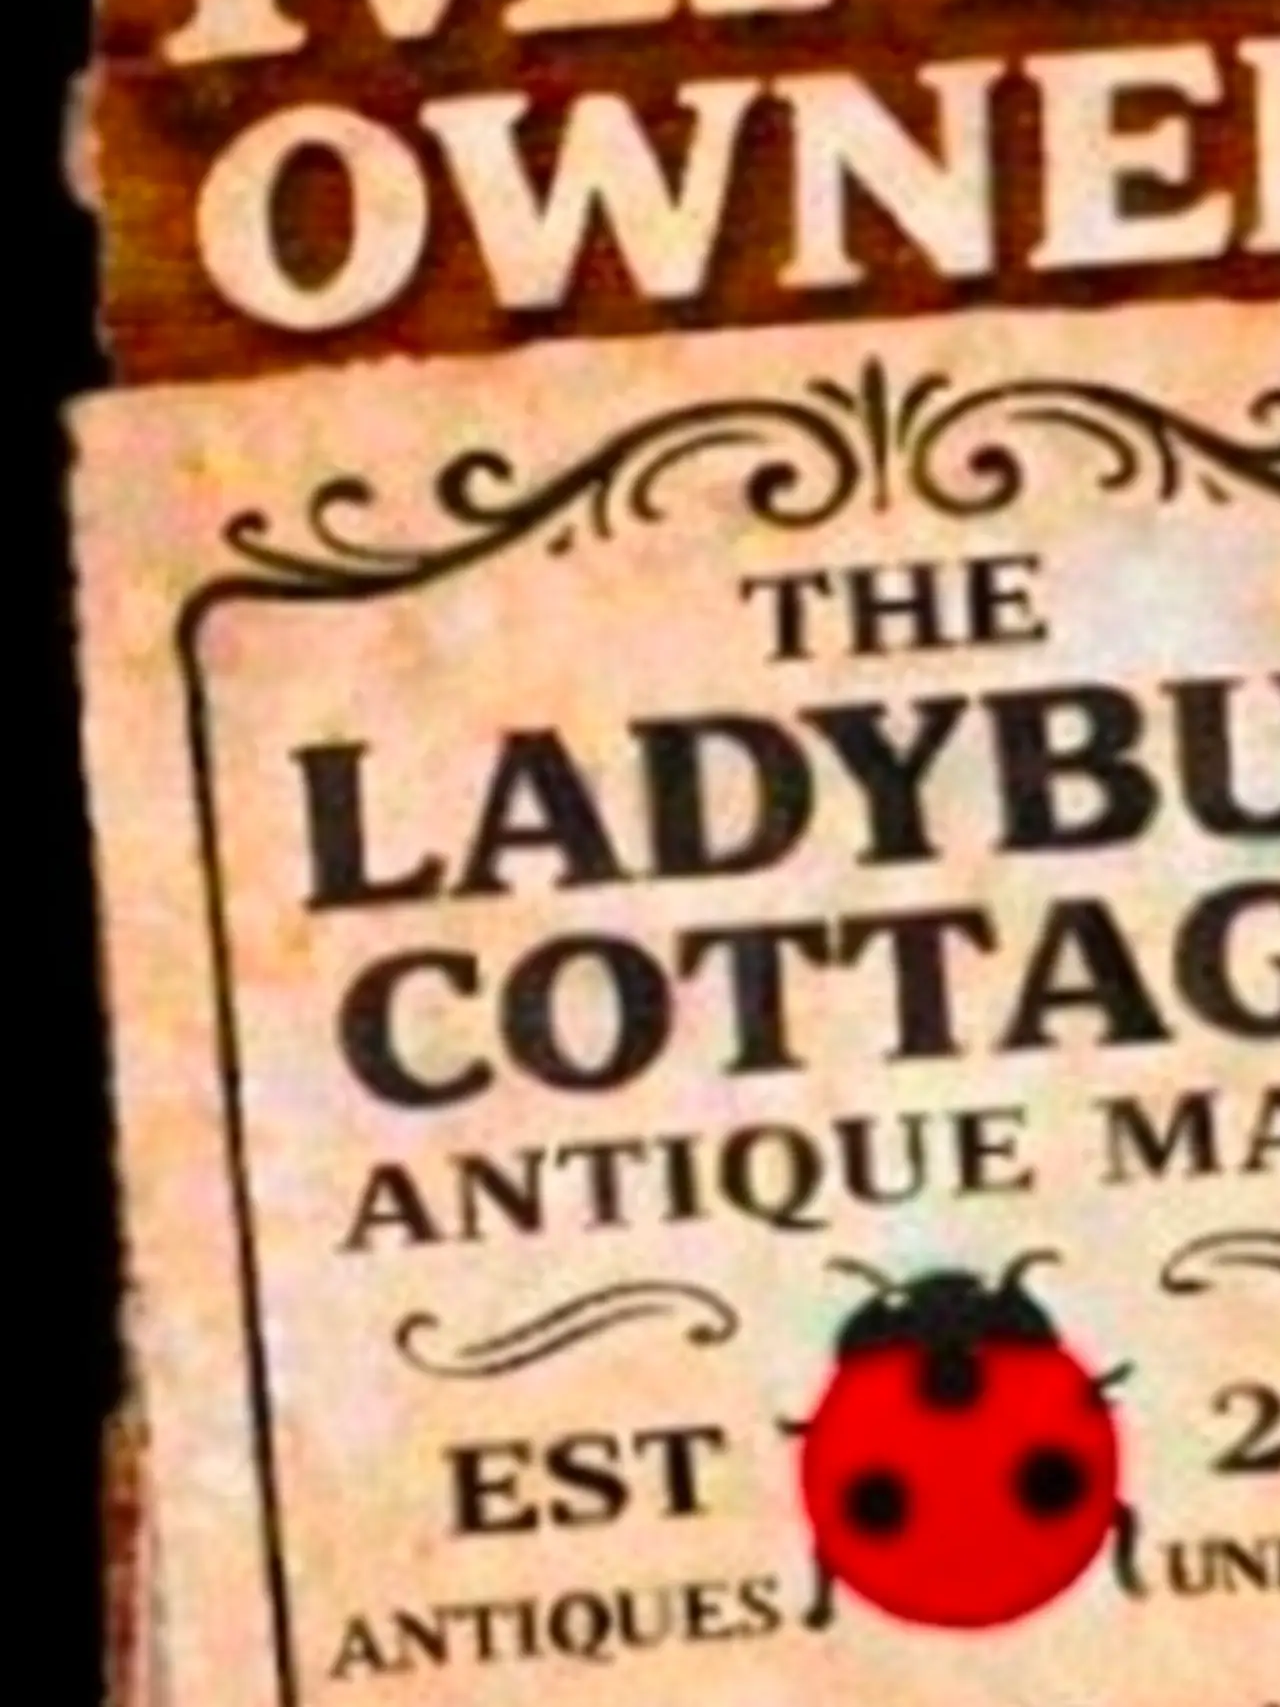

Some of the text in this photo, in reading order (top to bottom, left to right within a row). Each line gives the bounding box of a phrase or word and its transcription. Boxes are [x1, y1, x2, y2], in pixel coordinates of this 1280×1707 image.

[740, 552, 1050, 662] THE
[340, 1104, 1035, 1253] ANTIQUE
[442, 1424, 728, 1537] EST
[328, 1576, 785, 1681] ANTIQUES
